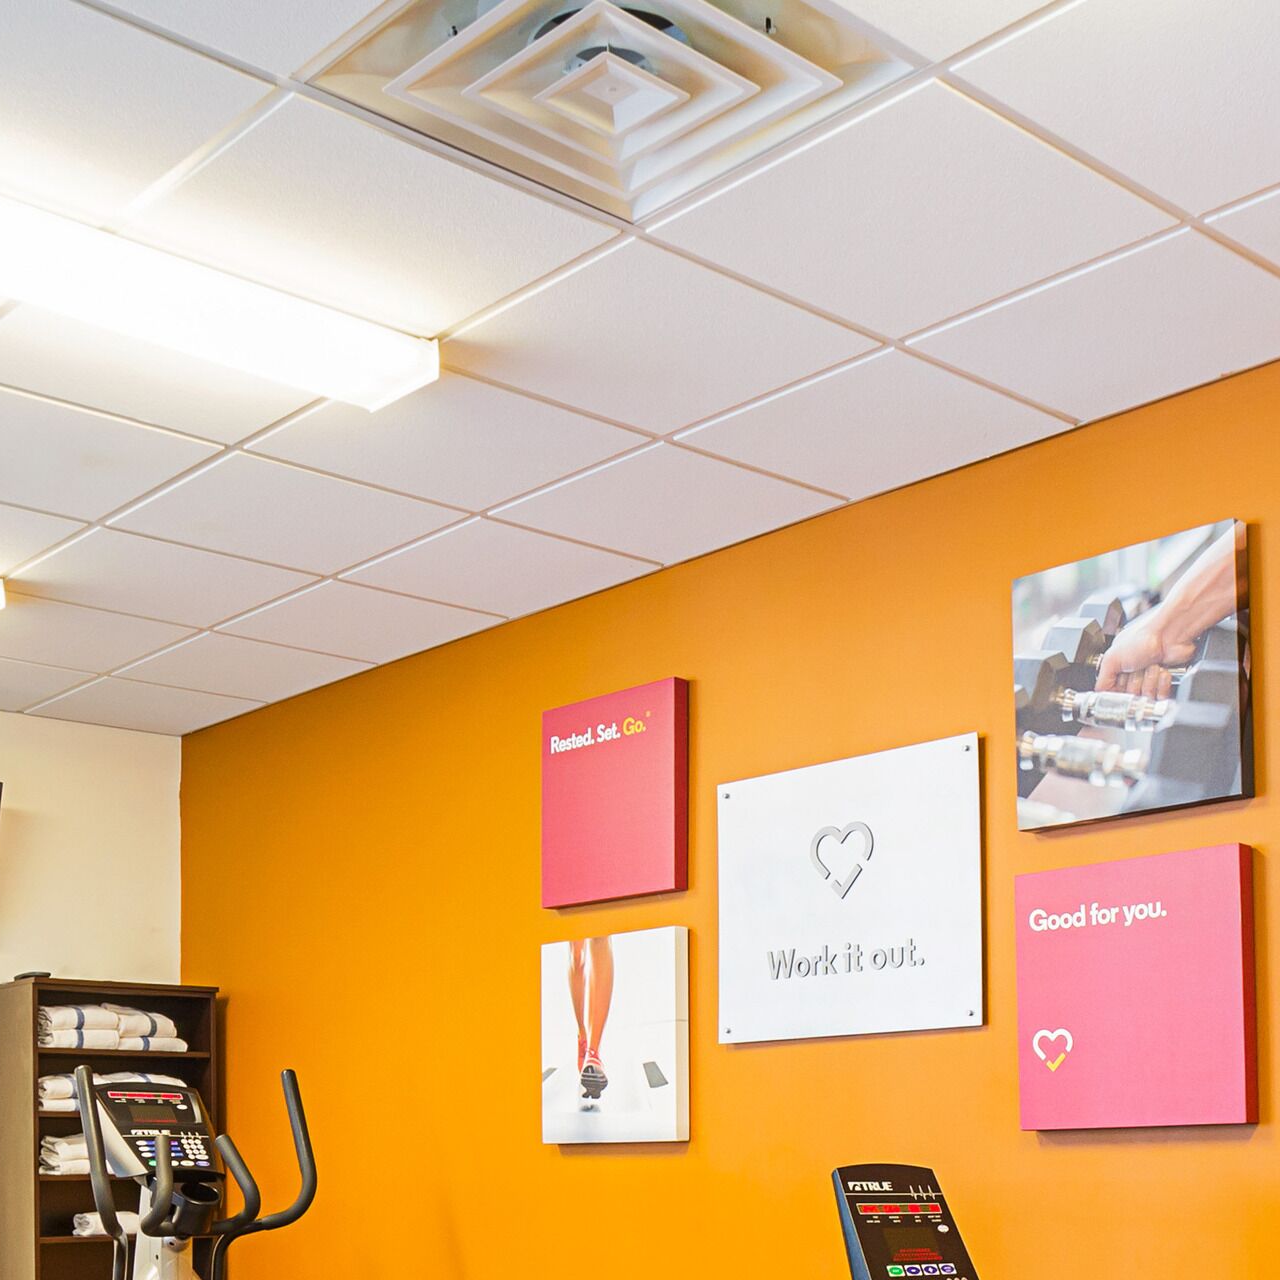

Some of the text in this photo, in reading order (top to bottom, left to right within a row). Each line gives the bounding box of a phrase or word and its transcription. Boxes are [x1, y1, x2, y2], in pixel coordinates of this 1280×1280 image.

[550, 716, 646, 754] Rested. Set. Go.
[1029, 901, 1167, 932] Good for you.
[767, 938, 925, 980] Work it out.
[862, 1181, 893, 1191] TRUE
